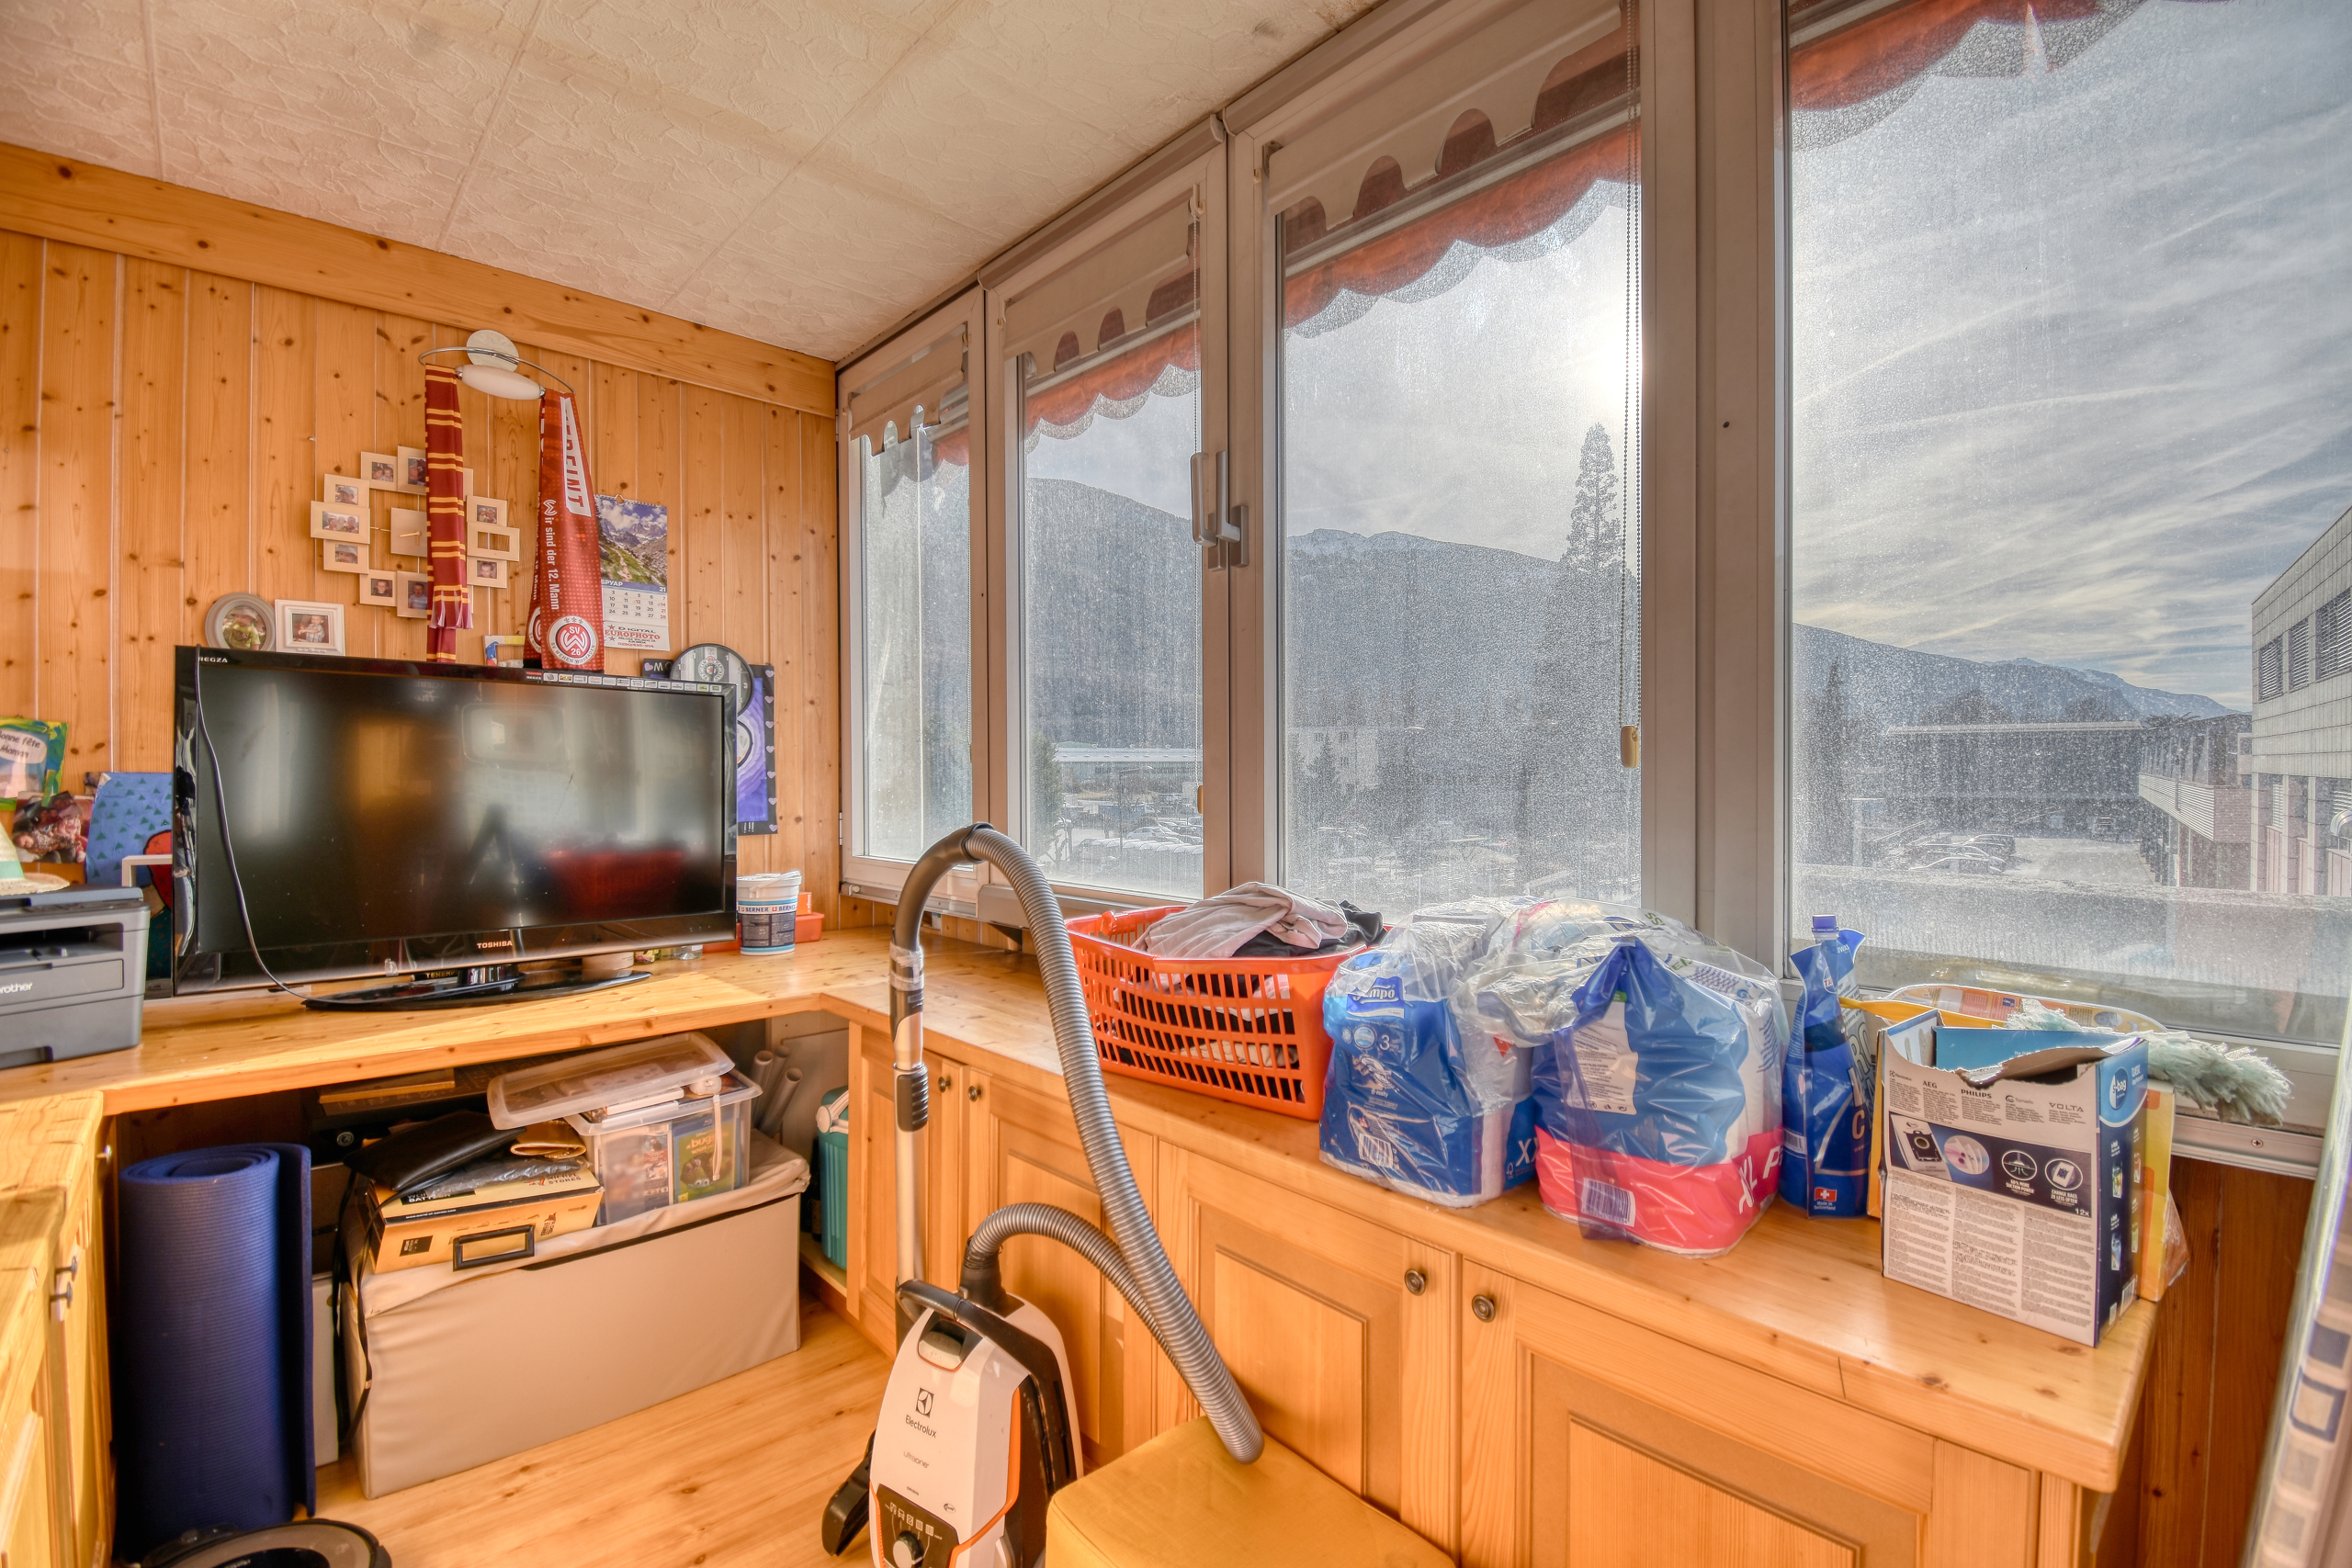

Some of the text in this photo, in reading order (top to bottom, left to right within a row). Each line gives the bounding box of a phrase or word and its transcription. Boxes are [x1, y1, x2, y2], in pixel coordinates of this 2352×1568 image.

[565, 410, 585, 508] EINT
[543, 499, 561, 611] Wir sind der 12. Mann
[569, 626, 581, 635] SV
[605, 629, 661, 640] EUROPHOTO
[555, 650, 574, 663] WEHEN
[571, 648, 582, 656] 26
[22, 737, 40, 748] fête
[476, 940, 513, 950] TOSHIBA
[0, 983, 33, 994] rother
[1353, 988, 1396, 1001] mpo
[1379, 1034, 1390, 1051] 3
[1922, 1080, 1938, 1089] AEG
[1961, 1089, 1992, 1099] PHILIPS
[2049, 1102, 2084, 1112] VOLTA
[2075, 1208, 2090, 1217] 12x
[905, 1414, 937, 1438] Electrolux
